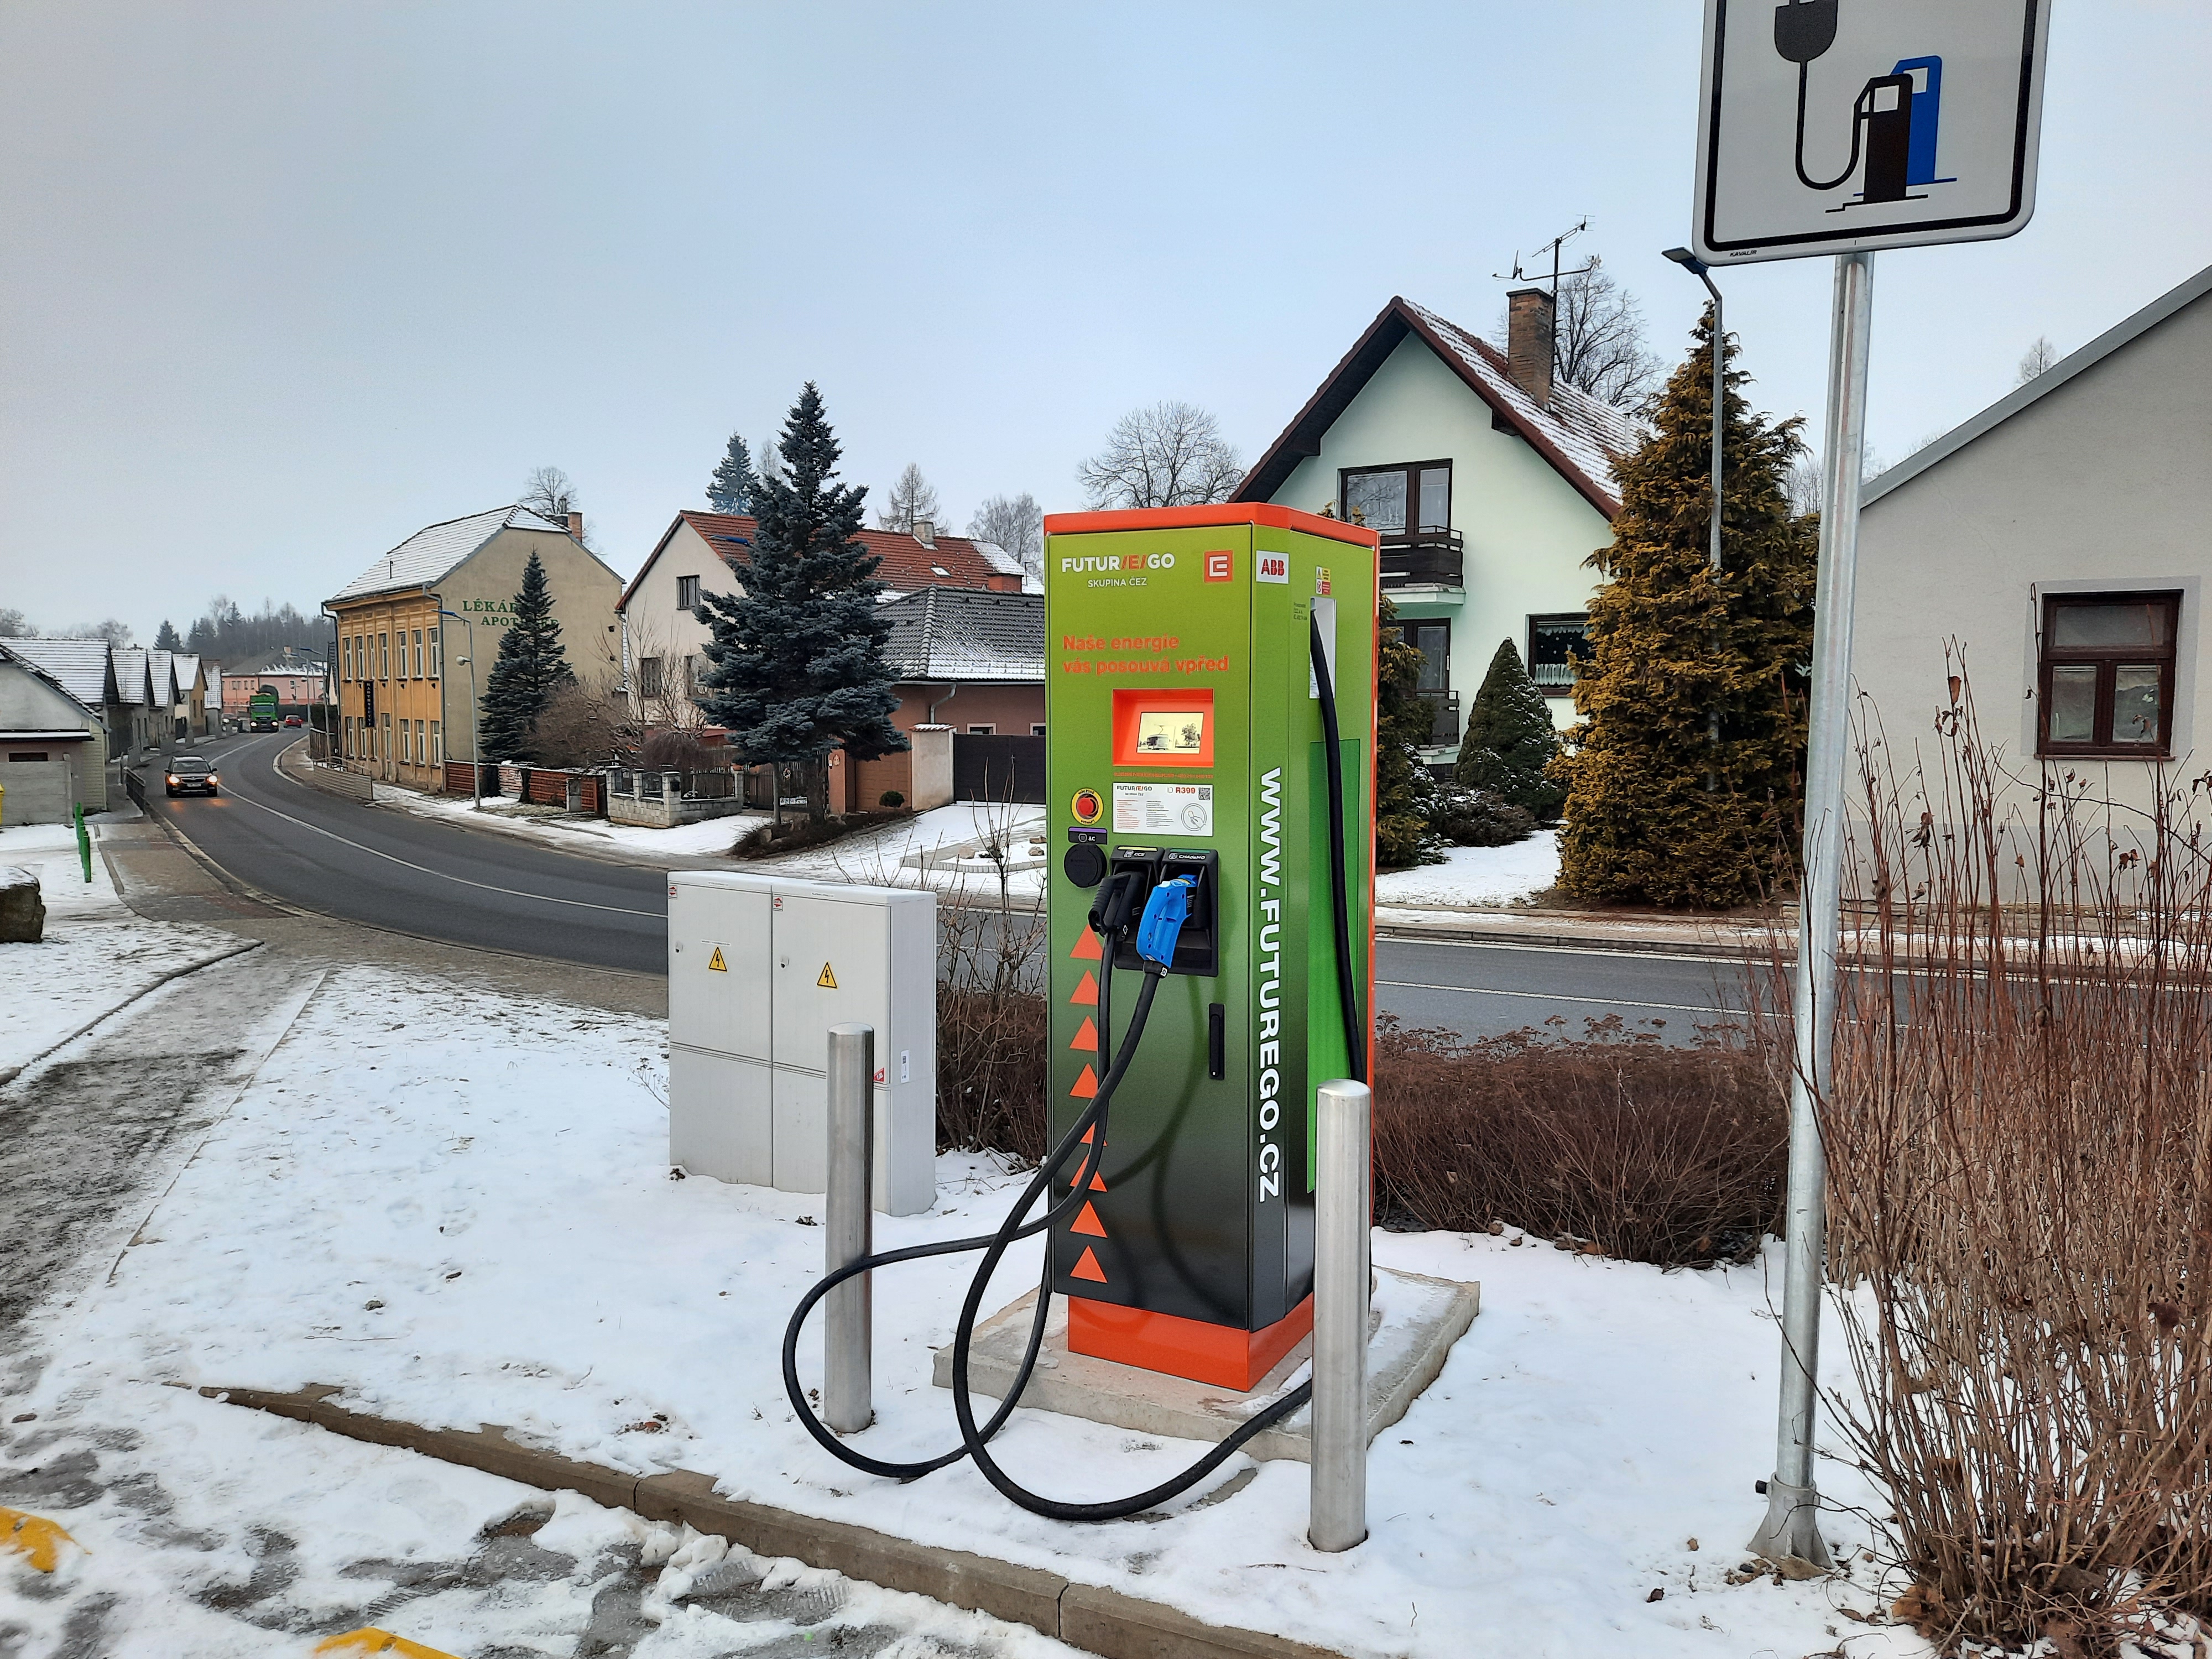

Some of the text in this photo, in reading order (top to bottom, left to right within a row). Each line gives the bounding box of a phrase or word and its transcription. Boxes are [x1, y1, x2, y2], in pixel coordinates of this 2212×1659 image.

[1261, 559, 1285, 576] ABB
[1088, 576, 1147, 588] SKUPINA ČEZ
[1063, 633, 1180, 653] Naše energie
[1063, 655, 1229, 676] vás posouvá vpřed
[1259, 766, 1281, 1204] WWW.FUTUREGO.CZ
